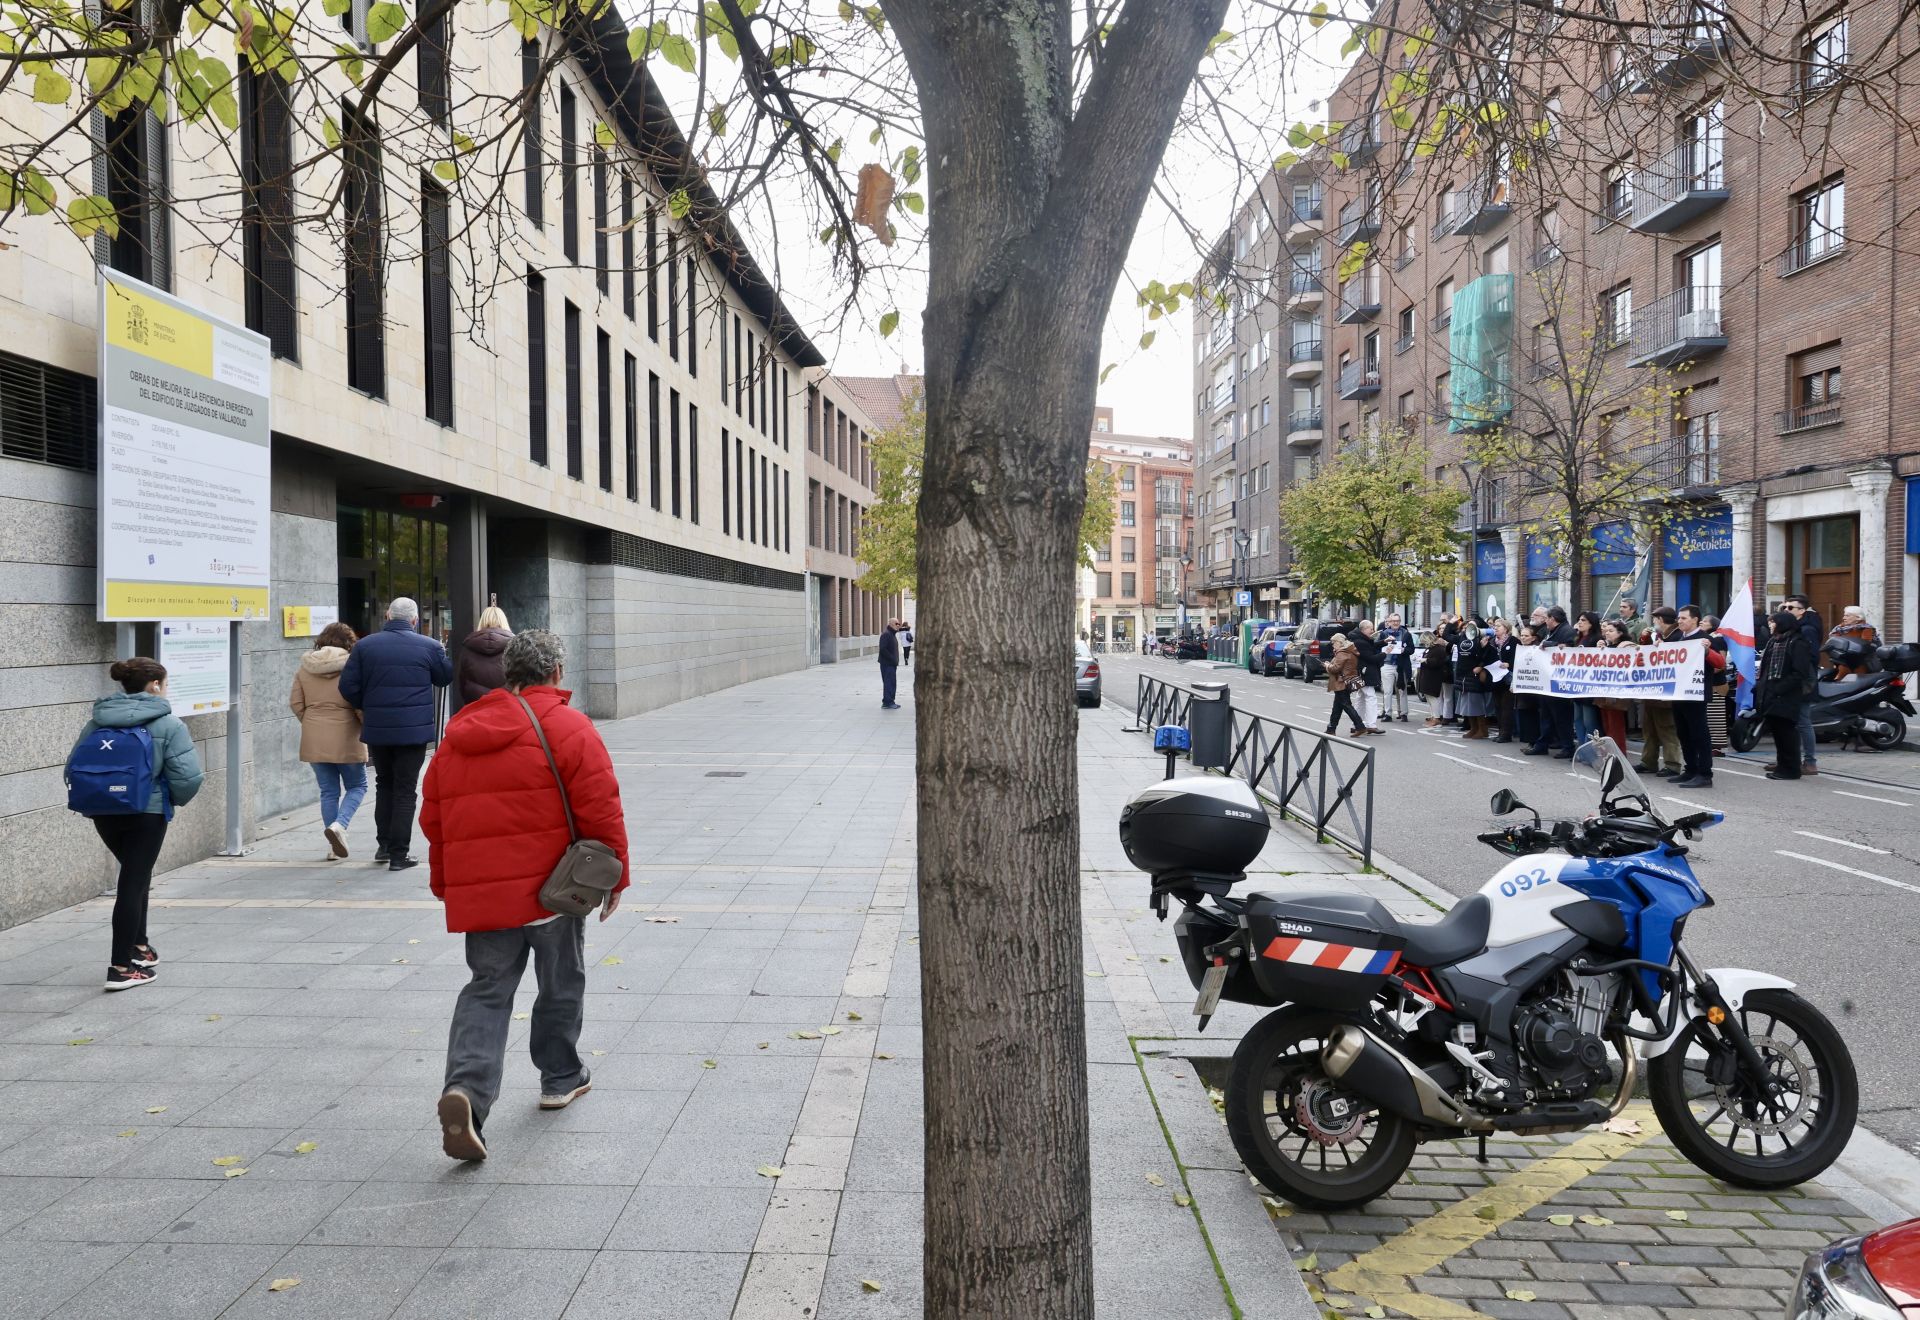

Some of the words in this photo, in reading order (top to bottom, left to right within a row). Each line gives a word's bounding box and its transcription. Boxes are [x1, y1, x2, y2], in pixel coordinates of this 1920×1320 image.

[130, 370, 150, 385] OBRAS
[151, 376, 160, 388] DE
[160, 379, 183, 396] MEJORA
[183, 387, 191, 398] DE
[191, 390, 198, 399] LA
[199, 392, 225, 408] EFICIENCIA
[139, 387, 151, 400] DEL
[152, 391, 175, 407] EDIFICIO
[175, 398, 184, 409] DE
[184, 401, 211, 417] JUZGADOS
[211, 408, 218, 420] DE
[219, 411, 247, 428] VALLADOLID
[111, 413, 140, 427] CONTRATISTA
[111, 446, 126, 457] PLAZO
[1690, 536, 1732, 552] Recoletas
[128, 596, 156, 604] Disculpen
[1551, 652, 1566, 666] SIN
[1568, 653, 1631, 668] ABOGADOS
[1649, 648, 1688, 666] OFICIO
[1552, 668, 1566, 678] NO
[1567, 668, 1588, 680] HAY
[1590, 669, 1629, 682] JUSTICIA
[1631, 667, 1676, 682] GRATUITA
[1558, 682, 1570, 692] POR
[1572, 684, 1584, 694] UN
[1586, 685, 1608, 695] TURNO
[1610, 686, 1619, 696] DE
[1643, 684, 1664, 696] DIGNO
[1500, 868, 1550, 898] 092
[1280, 922, 1312, 933] SHAD
